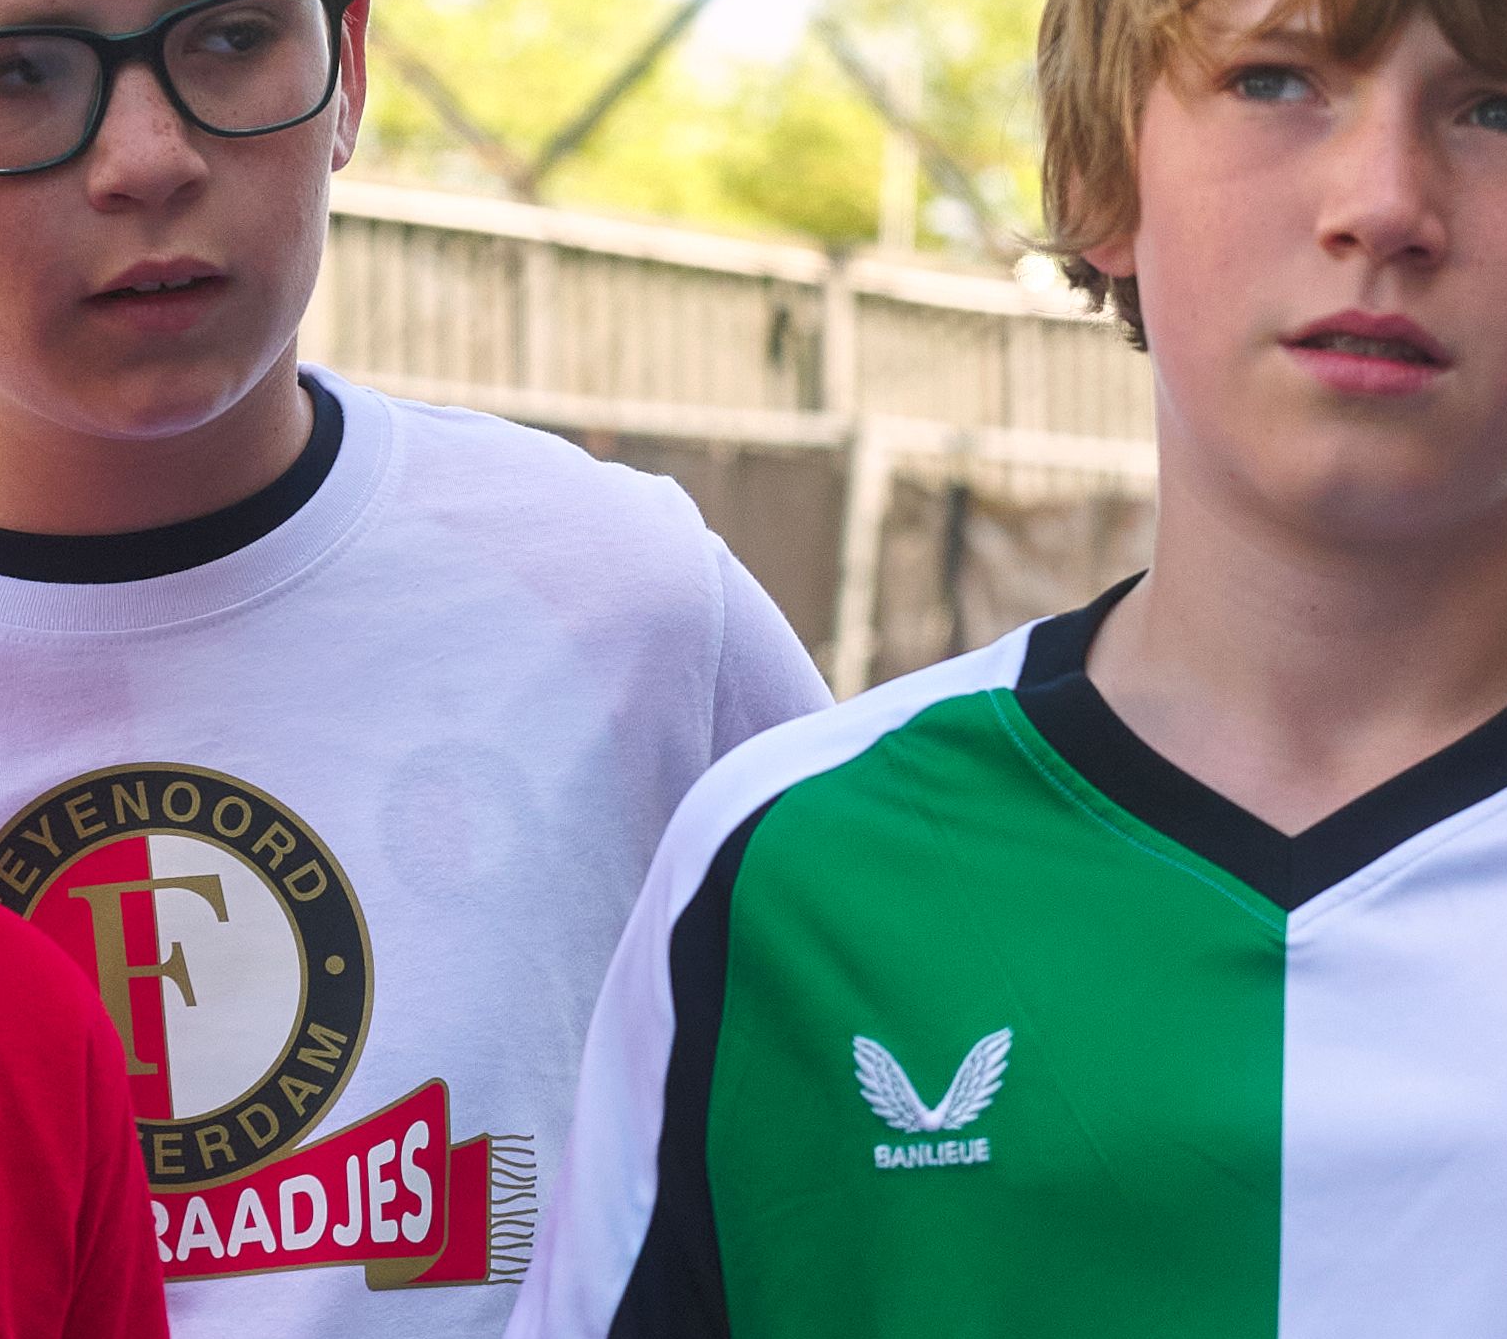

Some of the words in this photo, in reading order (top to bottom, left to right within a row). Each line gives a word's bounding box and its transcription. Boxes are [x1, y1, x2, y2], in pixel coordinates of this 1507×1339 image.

[67, 873, 230, 1076] F
[137, 1020, 349, 1176] ERDAM
[873, 1136, 991, 1169] BANLIEUE
